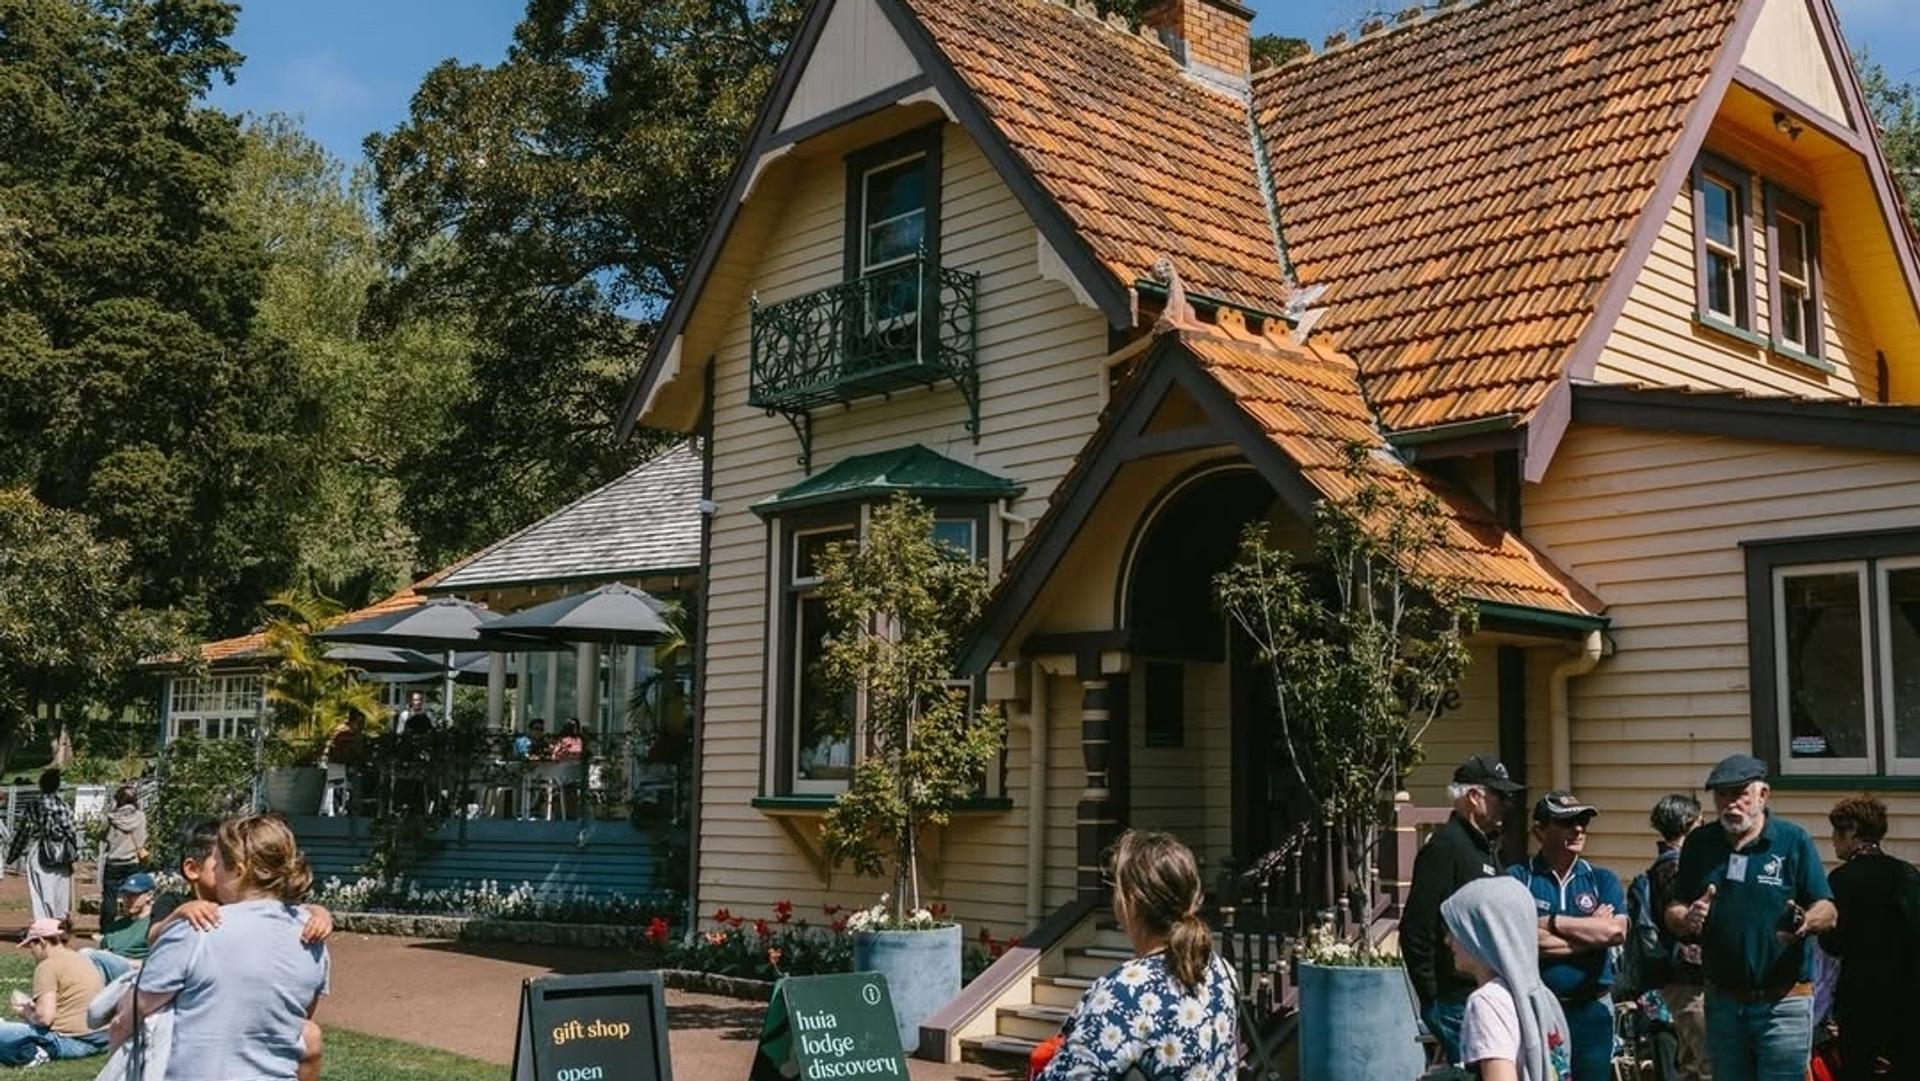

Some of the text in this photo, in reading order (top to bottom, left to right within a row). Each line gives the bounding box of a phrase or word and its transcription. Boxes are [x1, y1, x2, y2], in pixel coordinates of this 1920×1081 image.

[552, 1018, 631, 1045] gift shop
[797, 1010, 837, 1031] huia
[801, 1033, 855, 1058] lodge
[557, 1066, 603, 1081] open
[808, 1057, 898, 1079] discovery
